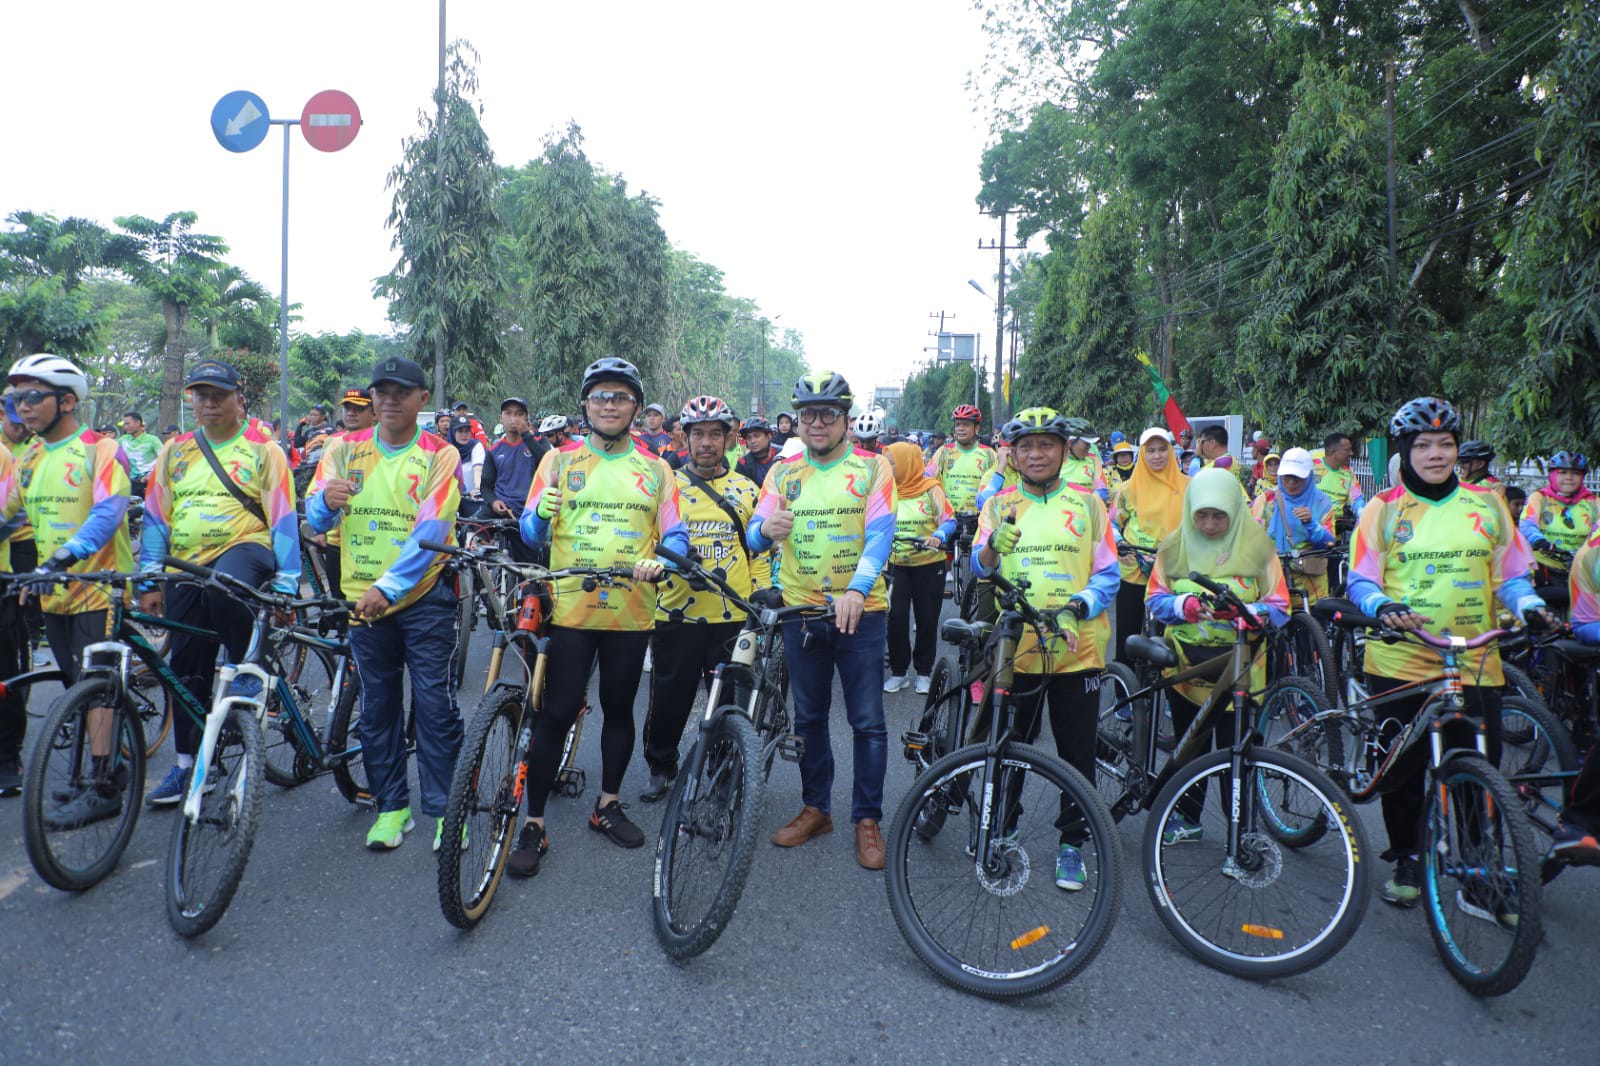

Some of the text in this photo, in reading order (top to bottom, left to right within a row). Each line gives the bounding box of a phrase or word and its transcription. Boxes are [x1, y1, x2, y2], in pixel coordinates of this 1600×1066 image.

[578, 501, 625, 510] SEKRETARIAT
[794, 507, 865, 517] SEKRETARIAT DAERAH
[1013, 544, 1053, 554] KRETARIAT
[1408, 550, 1463, 561] SEKRETARIAT
[1232, 777, 1241, 824] BREACH
[981, 782, 994, 831] BREACH
[1331, 801, 1361, 864] MAXXIS
